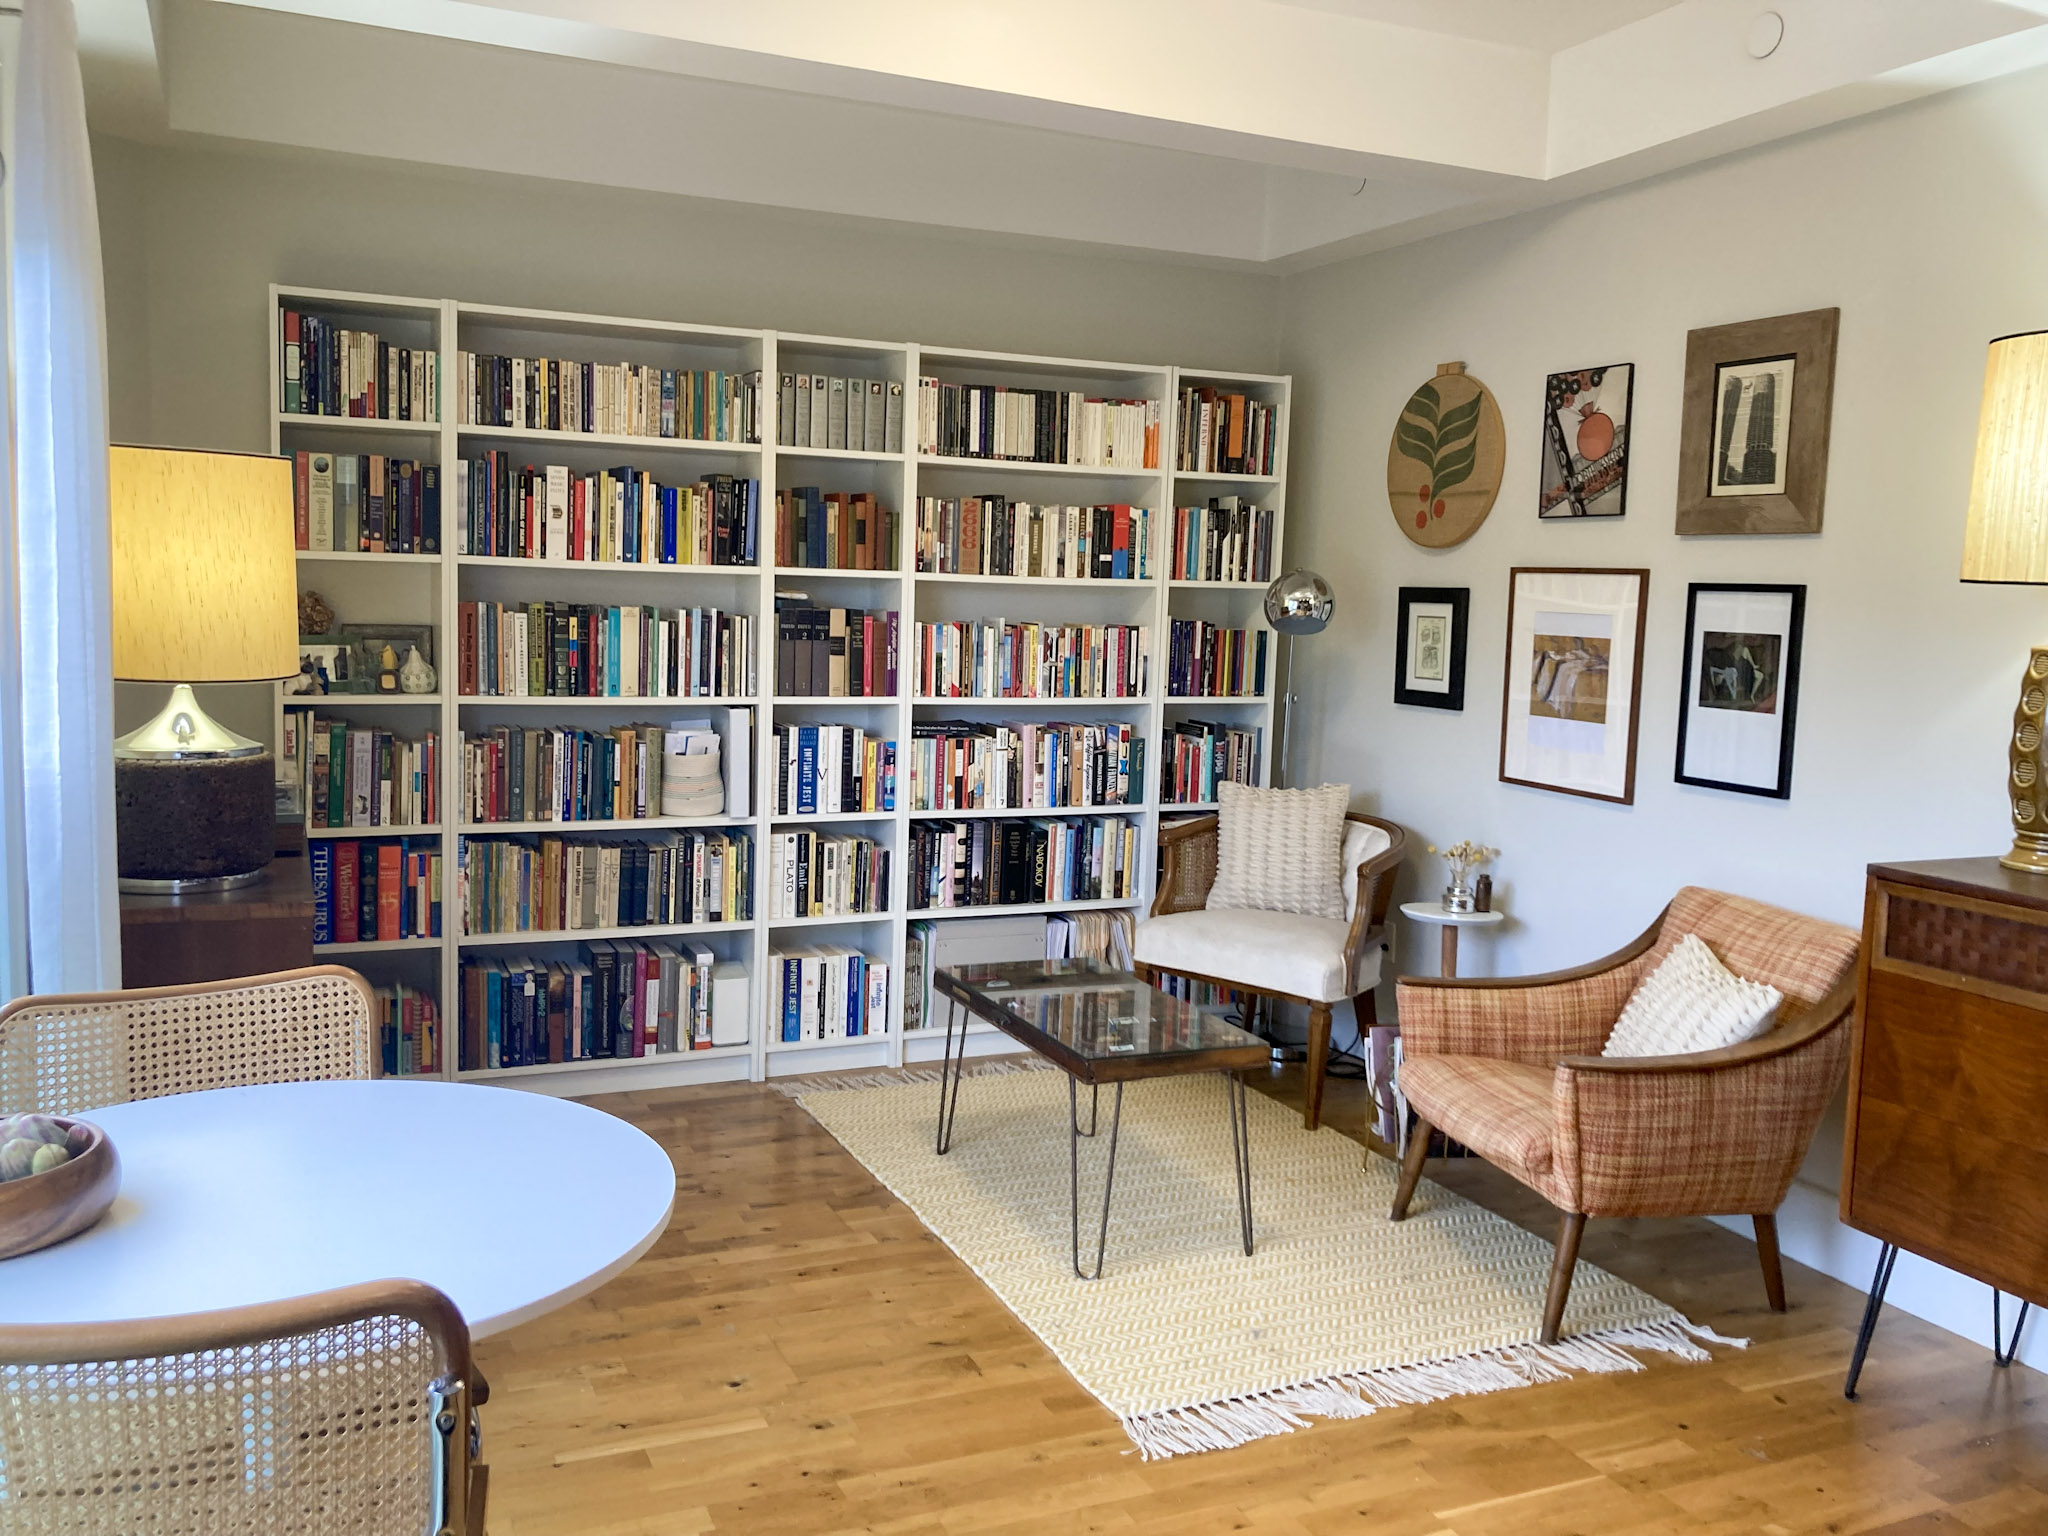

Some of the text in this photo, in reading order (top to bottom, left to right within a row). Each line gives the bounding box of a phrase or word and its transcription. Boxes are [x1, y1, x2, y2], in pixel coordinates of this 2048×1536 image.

[995, 498, 1003, 537] SOLENOID
[785, 632, 789, 640] 1
[801, 632, 807, 640] 2
[819, 632, 824, 641] 3
[802, 747, 813, 803] INFINITE JEST
[1083, 743, 1093, 790] Jeffrey Eugenides
[1107, 768, 1117, 793] FRANZEN
[786, 859, 794, 893] PLATO
[798, 862, 808, 890] Emile
[1034, 841, 1047, 888] NABOKOV
[313, 847, 328, 941] THESAURUS
[340, 863, 352, 920] Webster's
[537, 989, 546, 1017] MMPI-2
[788, 959, 798, 1015] INFINITE JEST
[875, 982, 883, 1006] Infinite
